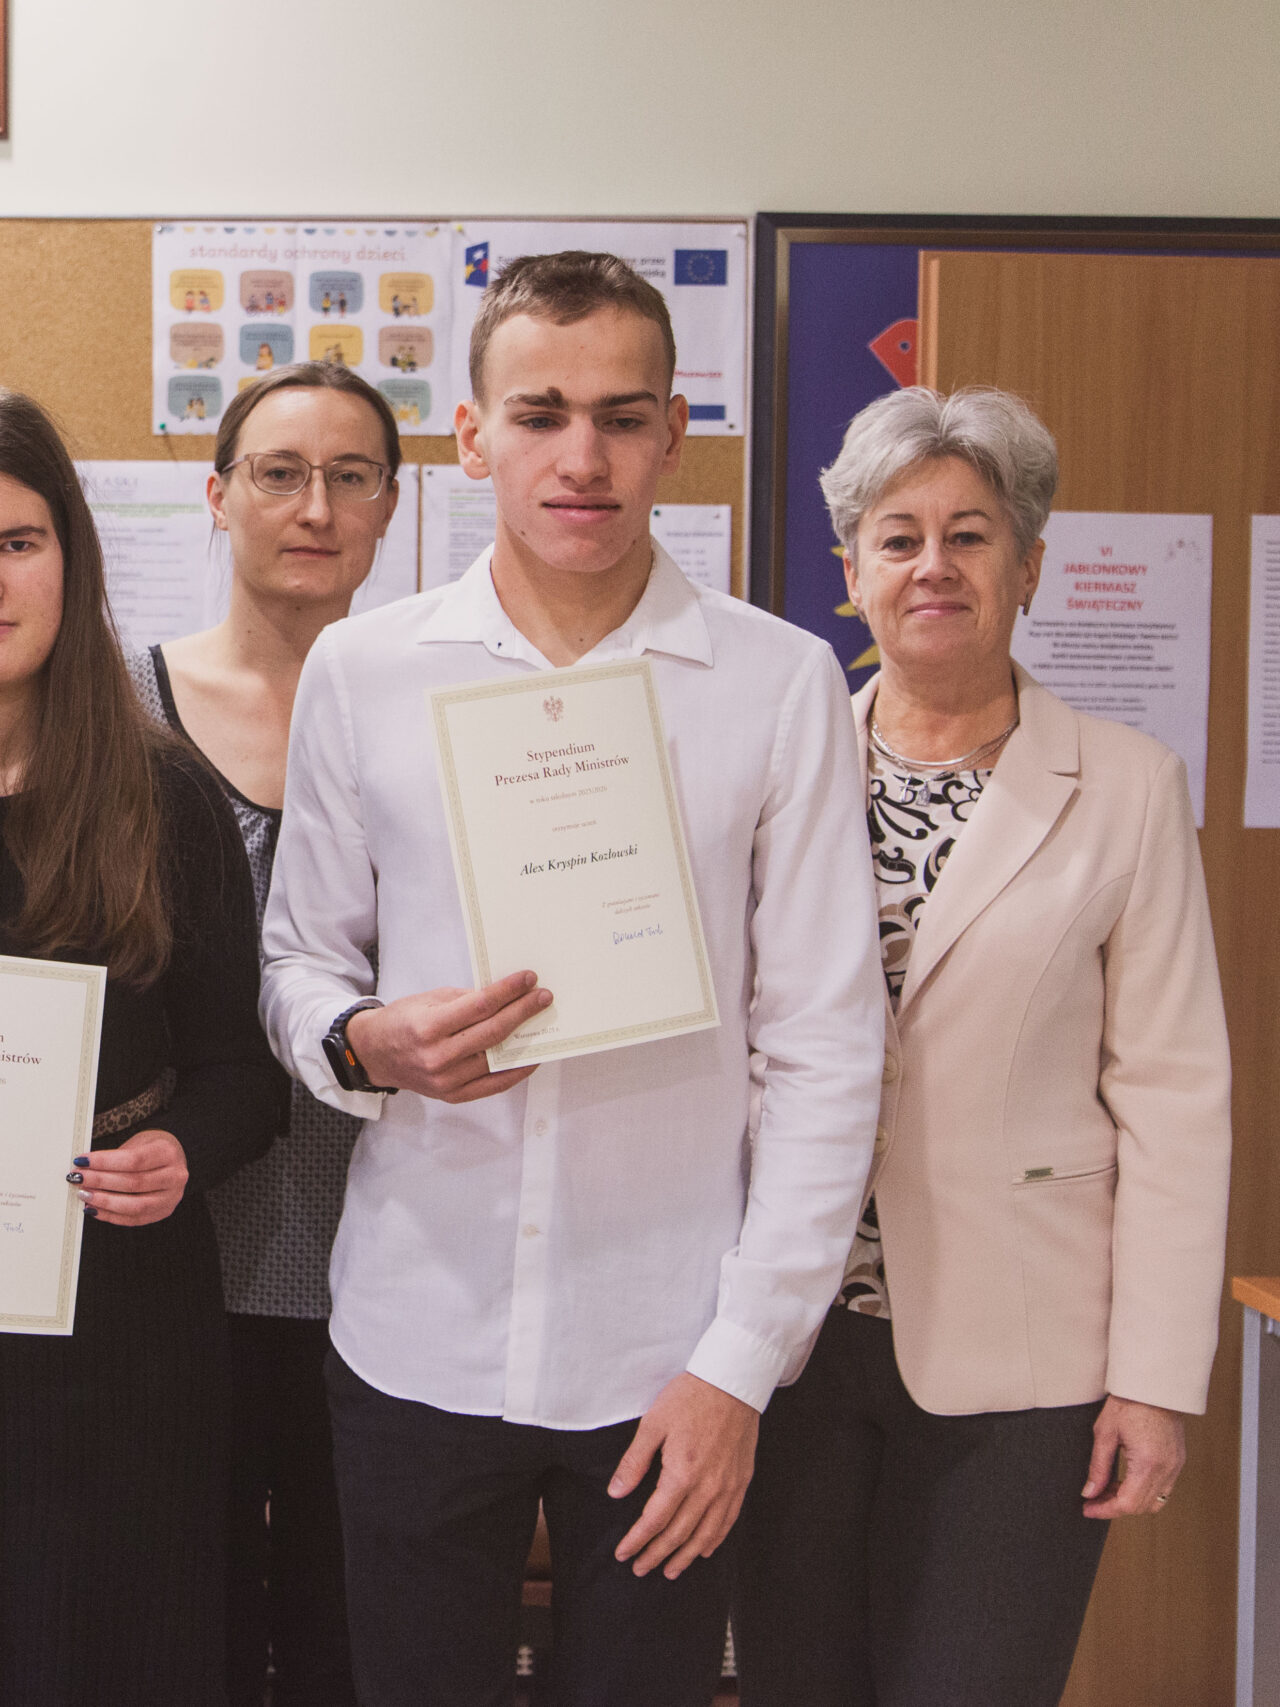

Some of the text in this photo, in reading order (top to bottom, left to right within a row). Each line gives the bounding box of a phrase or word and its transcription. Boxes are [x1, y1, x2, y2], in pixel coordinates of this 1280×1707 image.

[189, 244, 406, 264] standardy ochrony dzieci
[1100, 546, 1113, 557] VI
[1074, 581, 1137, 593] KIERMASZ
[526, 743, 595, 764] Stypendium
[494, 754, 630, 787] Prezesa Rady Ministrów
[520, 843, 639, 876] Alex Kryspin Kozłowski
